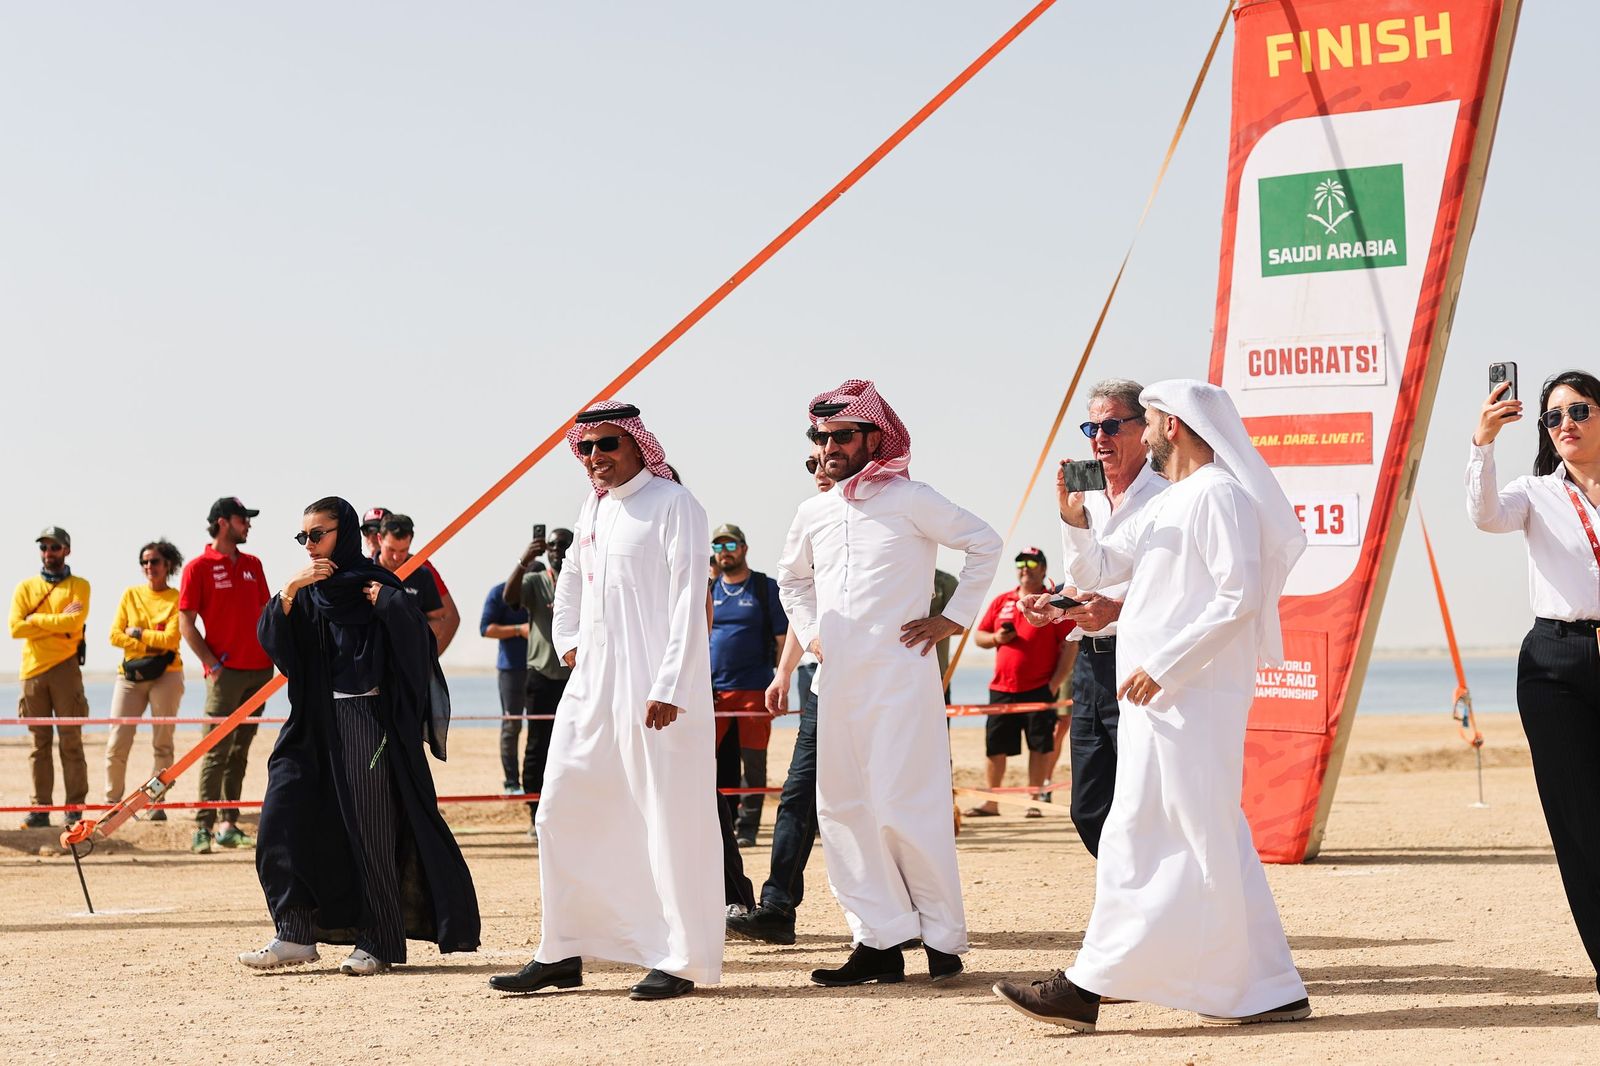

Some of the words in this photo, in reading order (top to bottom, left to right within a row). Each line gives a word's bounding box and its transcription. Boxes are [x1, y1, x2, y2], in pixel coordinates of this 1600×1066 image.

[1266, 11, 1453, 78] FINISH
[1268, 244, 1322, 265] SAUDI
[1326, 238, 1397, 261] ARABIA
[1248, 345, 1378, 377] CONGRATS!
[1249, 435, 1281, 447] EAM.
[1283, 433, 1319, 446] DARE.
[1321, 432, 1350, 445] LIVE
[1350, 431, 1365, 444] IT.
[1313, 504, 1344, 535] 13
[1255, 671, 1317, 687] ALLY-RAID
[1255, 687, 1319, 700] AMPIONSHIP
